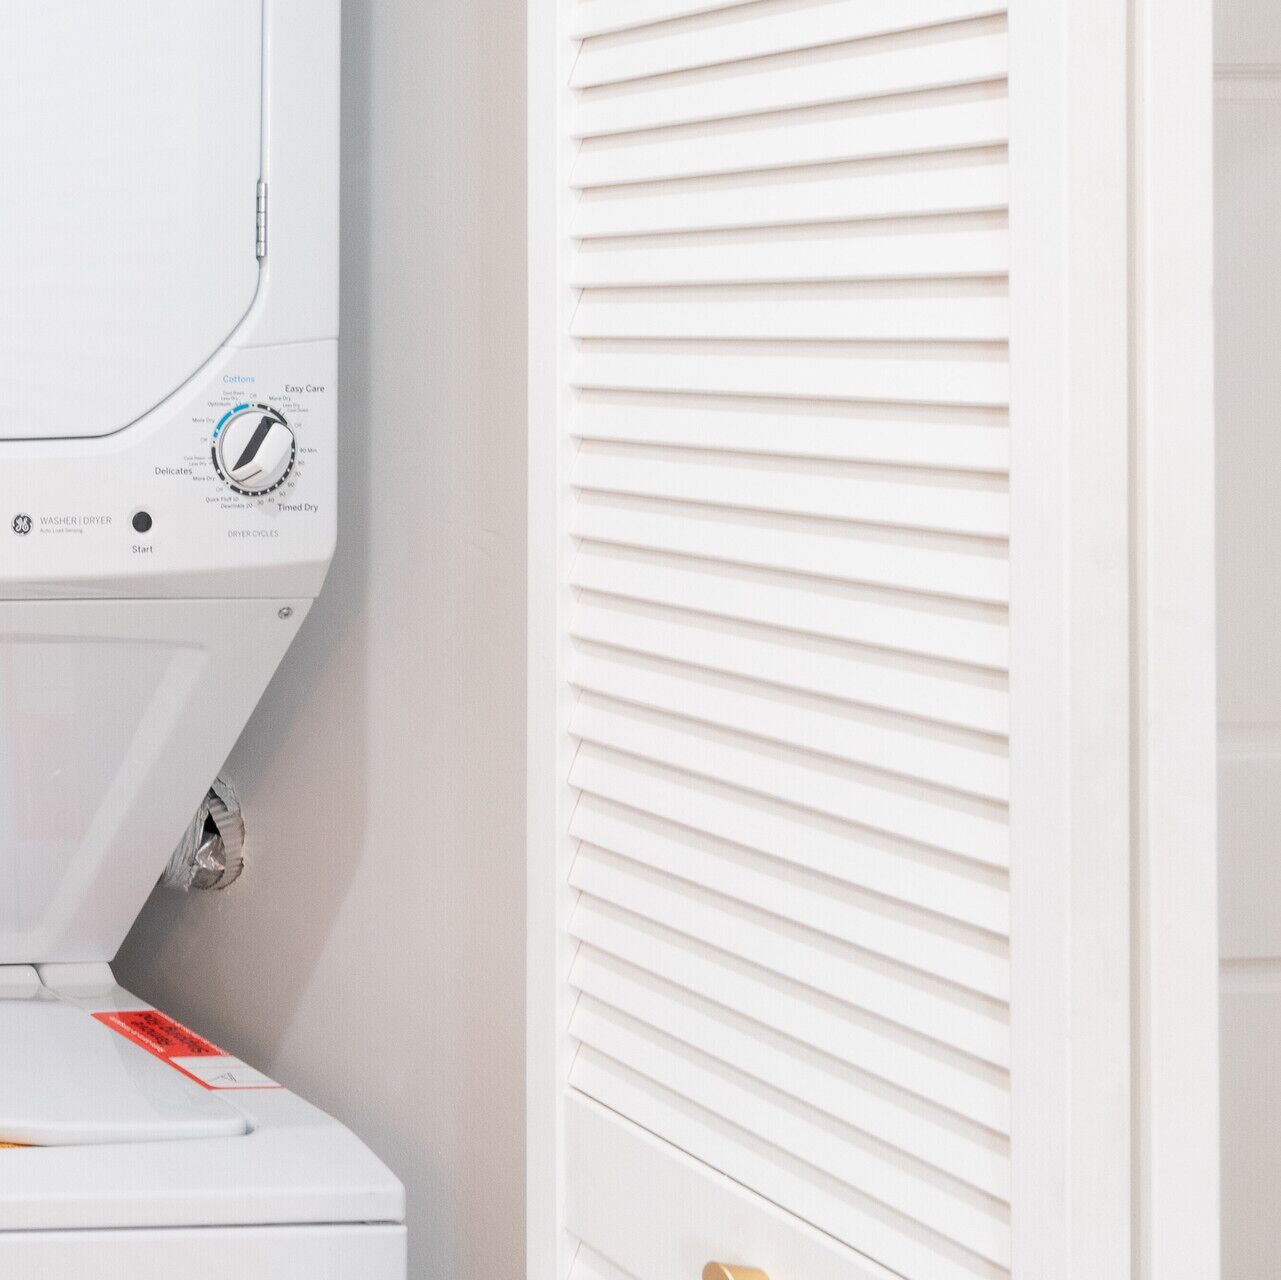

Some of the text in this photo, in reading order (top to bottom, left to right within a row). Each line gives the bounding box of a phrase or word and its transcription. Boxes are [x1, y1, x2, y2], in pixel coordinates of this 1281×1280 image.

[223, 375, 256, 384] Cottons
[284, 384, 326, 394] Easy Care
[154, 466, 193, 476] Delicates
[277, 503, 319, 513] Timed Dry
[40, 516, 113, 525] WASHER DRYER
[227, 530, 279, 538] DRYER CYCLES
[131, 545, 154, 554] Start
